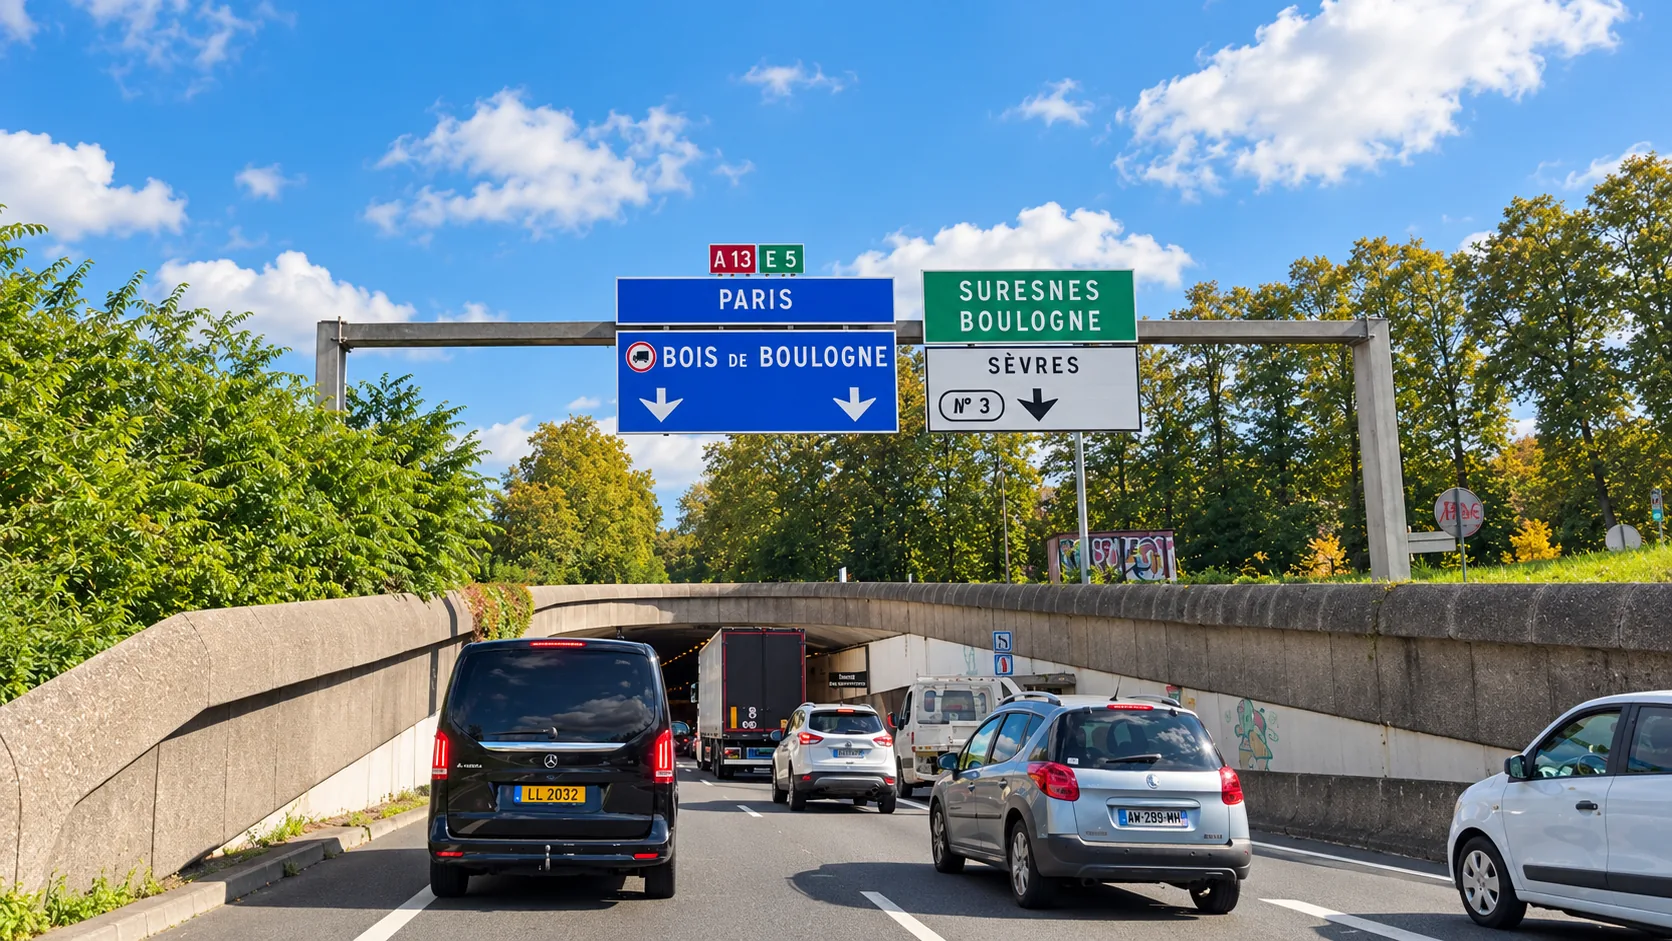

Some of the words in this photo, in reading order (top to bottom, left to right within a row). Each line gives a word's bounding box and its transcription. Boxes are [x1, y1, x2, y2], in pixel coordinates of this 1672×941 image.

[714, 250, 726, 268] A
[731, 250, 752, 268] 13
[766, 250, 777, 268] E
[785, 250, 797, 268] 5
[719, 288, 793, 310] PARIS
[959, 279, 1100, 302] SURESNES
[960, 309, 1101, 332] BOULOGNE
[663, 346, 718, 368] BOIS
[728, 353, 748, 368] DE
[759, 346, 888, 368] BOULOGNE
[988, 352, 1079, 375] SÈVRES
[979, 397, 990, 414] 3
[527, 788, 543, 801] LL
[546, 787, 579, 801] 2032
